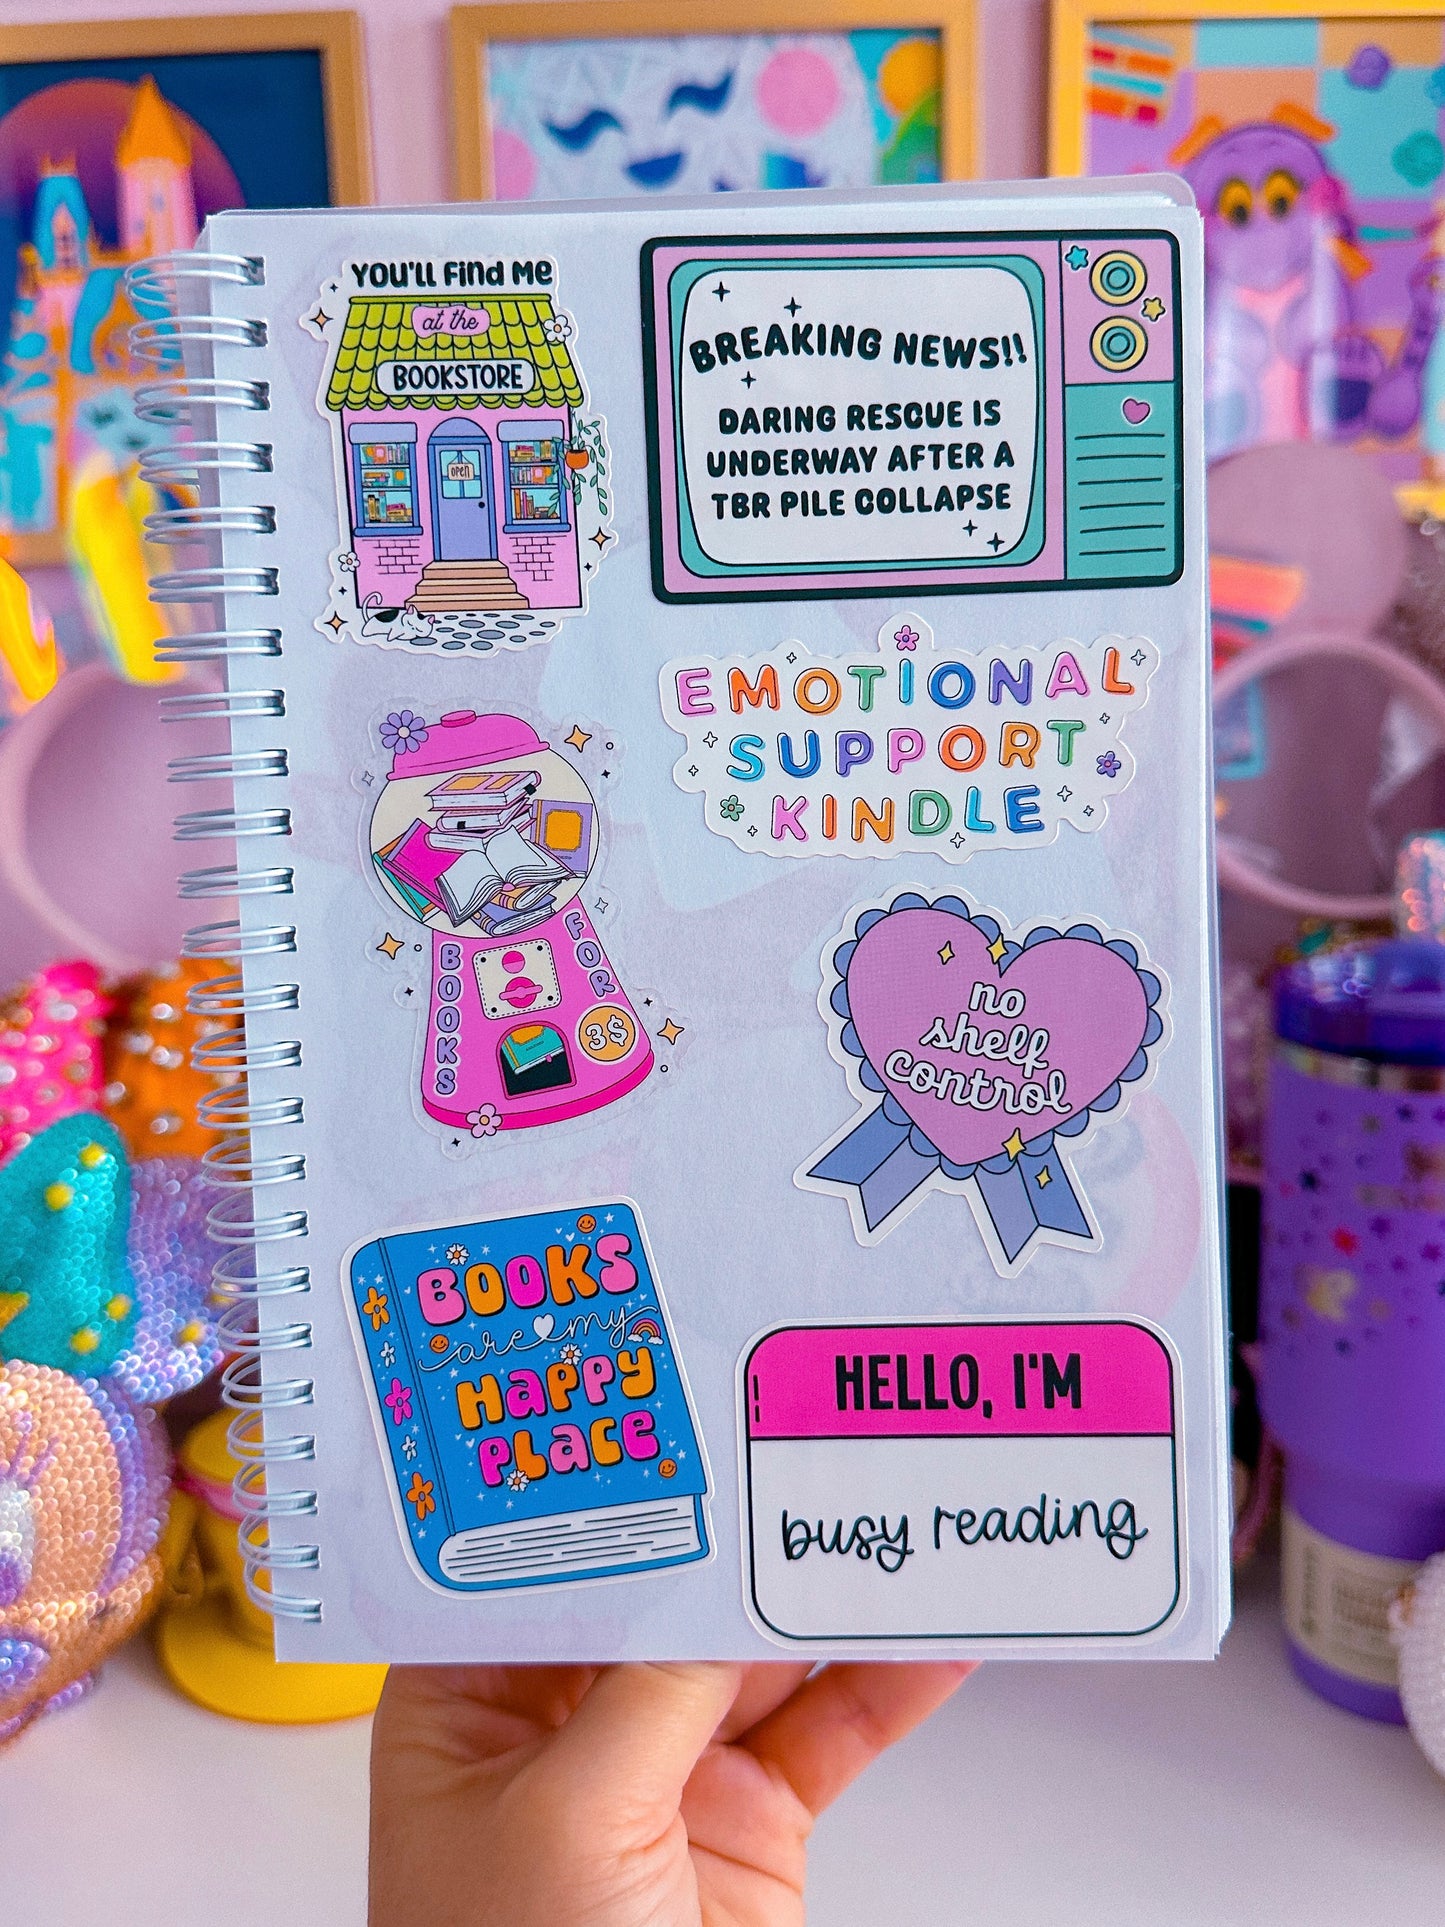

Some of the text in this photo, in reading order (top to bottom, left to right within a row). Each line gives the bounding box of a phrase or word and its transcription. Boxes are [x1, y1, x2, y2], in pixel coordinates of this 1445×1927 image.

[350, 261, 437, 287] YOU'LL
[422, 308, 479, 331] at the
[689, 323, 1028, 374] BREAKING NEWS!!
[393, 364, 523, 390] BOOKSTORE
[718, 399, 1002, 435] DARING RESCUE IS
[706, 441, 1015, 478] UNDERWAY AFTER A
[712, 484, 1011, 520] TBR PILE COLLAPSE
[675, 646, 1135, 716] EMOTIONAL
[726, 719, 1085, 781] SUPPORT
[771, 784, 1045, 842] KINDLE
[564, 910, 616, 999] FOR
[436, 942, 462, 1095] BOOKS
[968, 981, 1026, 1018] no
[583, 1015, 629, 1051] 3$
[919, 1013, 1050, 1078] shelf
[884, 1050, 1072, 1115] control
[416, 1233, 638, 1326] BOOKS
[417, 1304, 658, 1372] are my
[834, 1353, 1082, 1419] HELLO, I'M
[781, 1493, 1149, 1573] busy reading
